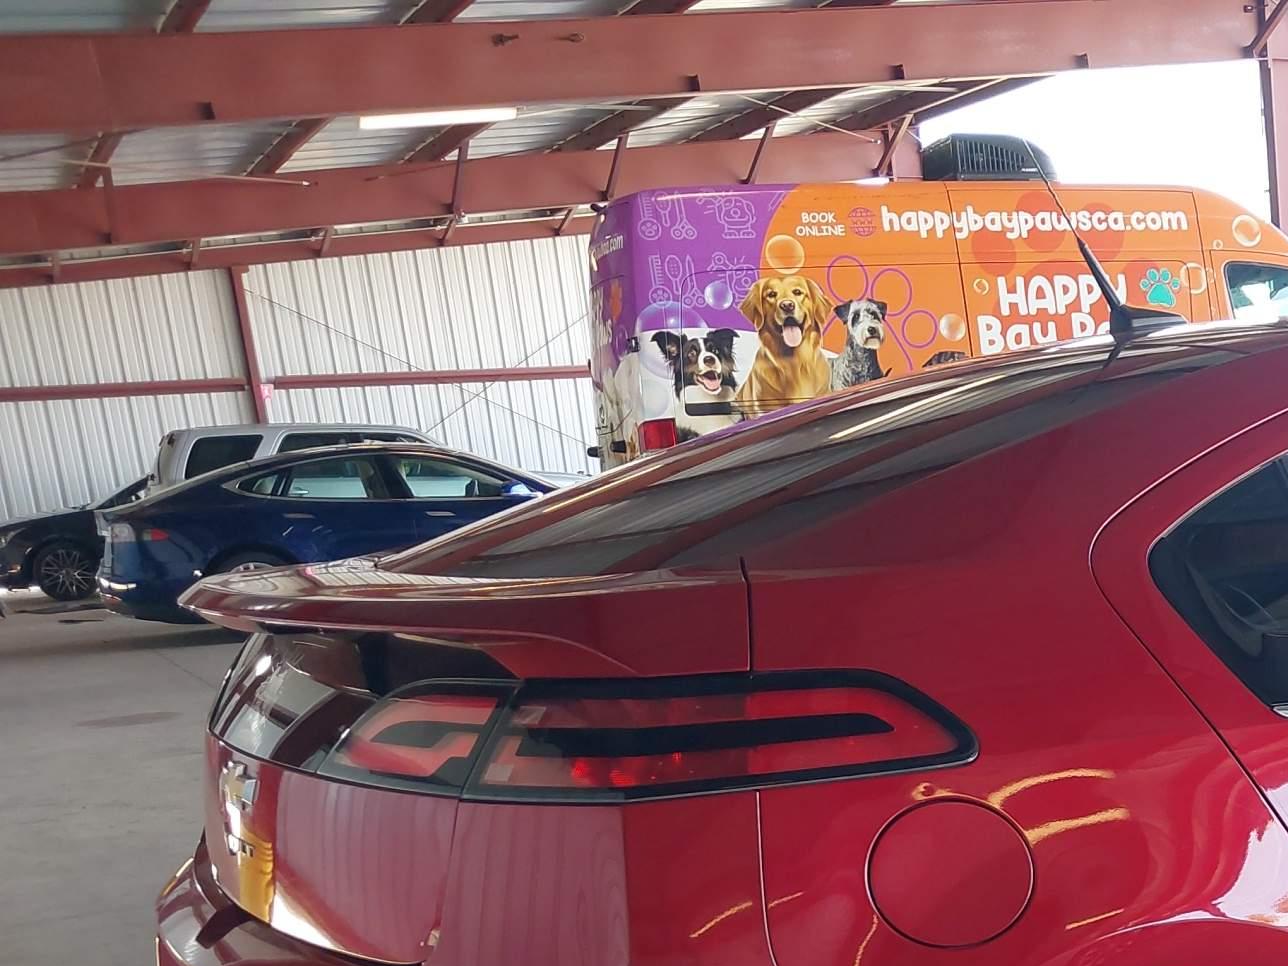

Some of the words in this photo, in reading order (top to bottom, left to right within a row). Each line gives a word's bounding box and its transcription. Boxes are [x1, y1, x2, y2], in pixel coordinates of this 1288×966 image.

[801, 211, 836, 223] BOOK
[881, 205, 1188, 240] happybaypawsca.com
[796, 224, 846, 236] ONLINE
